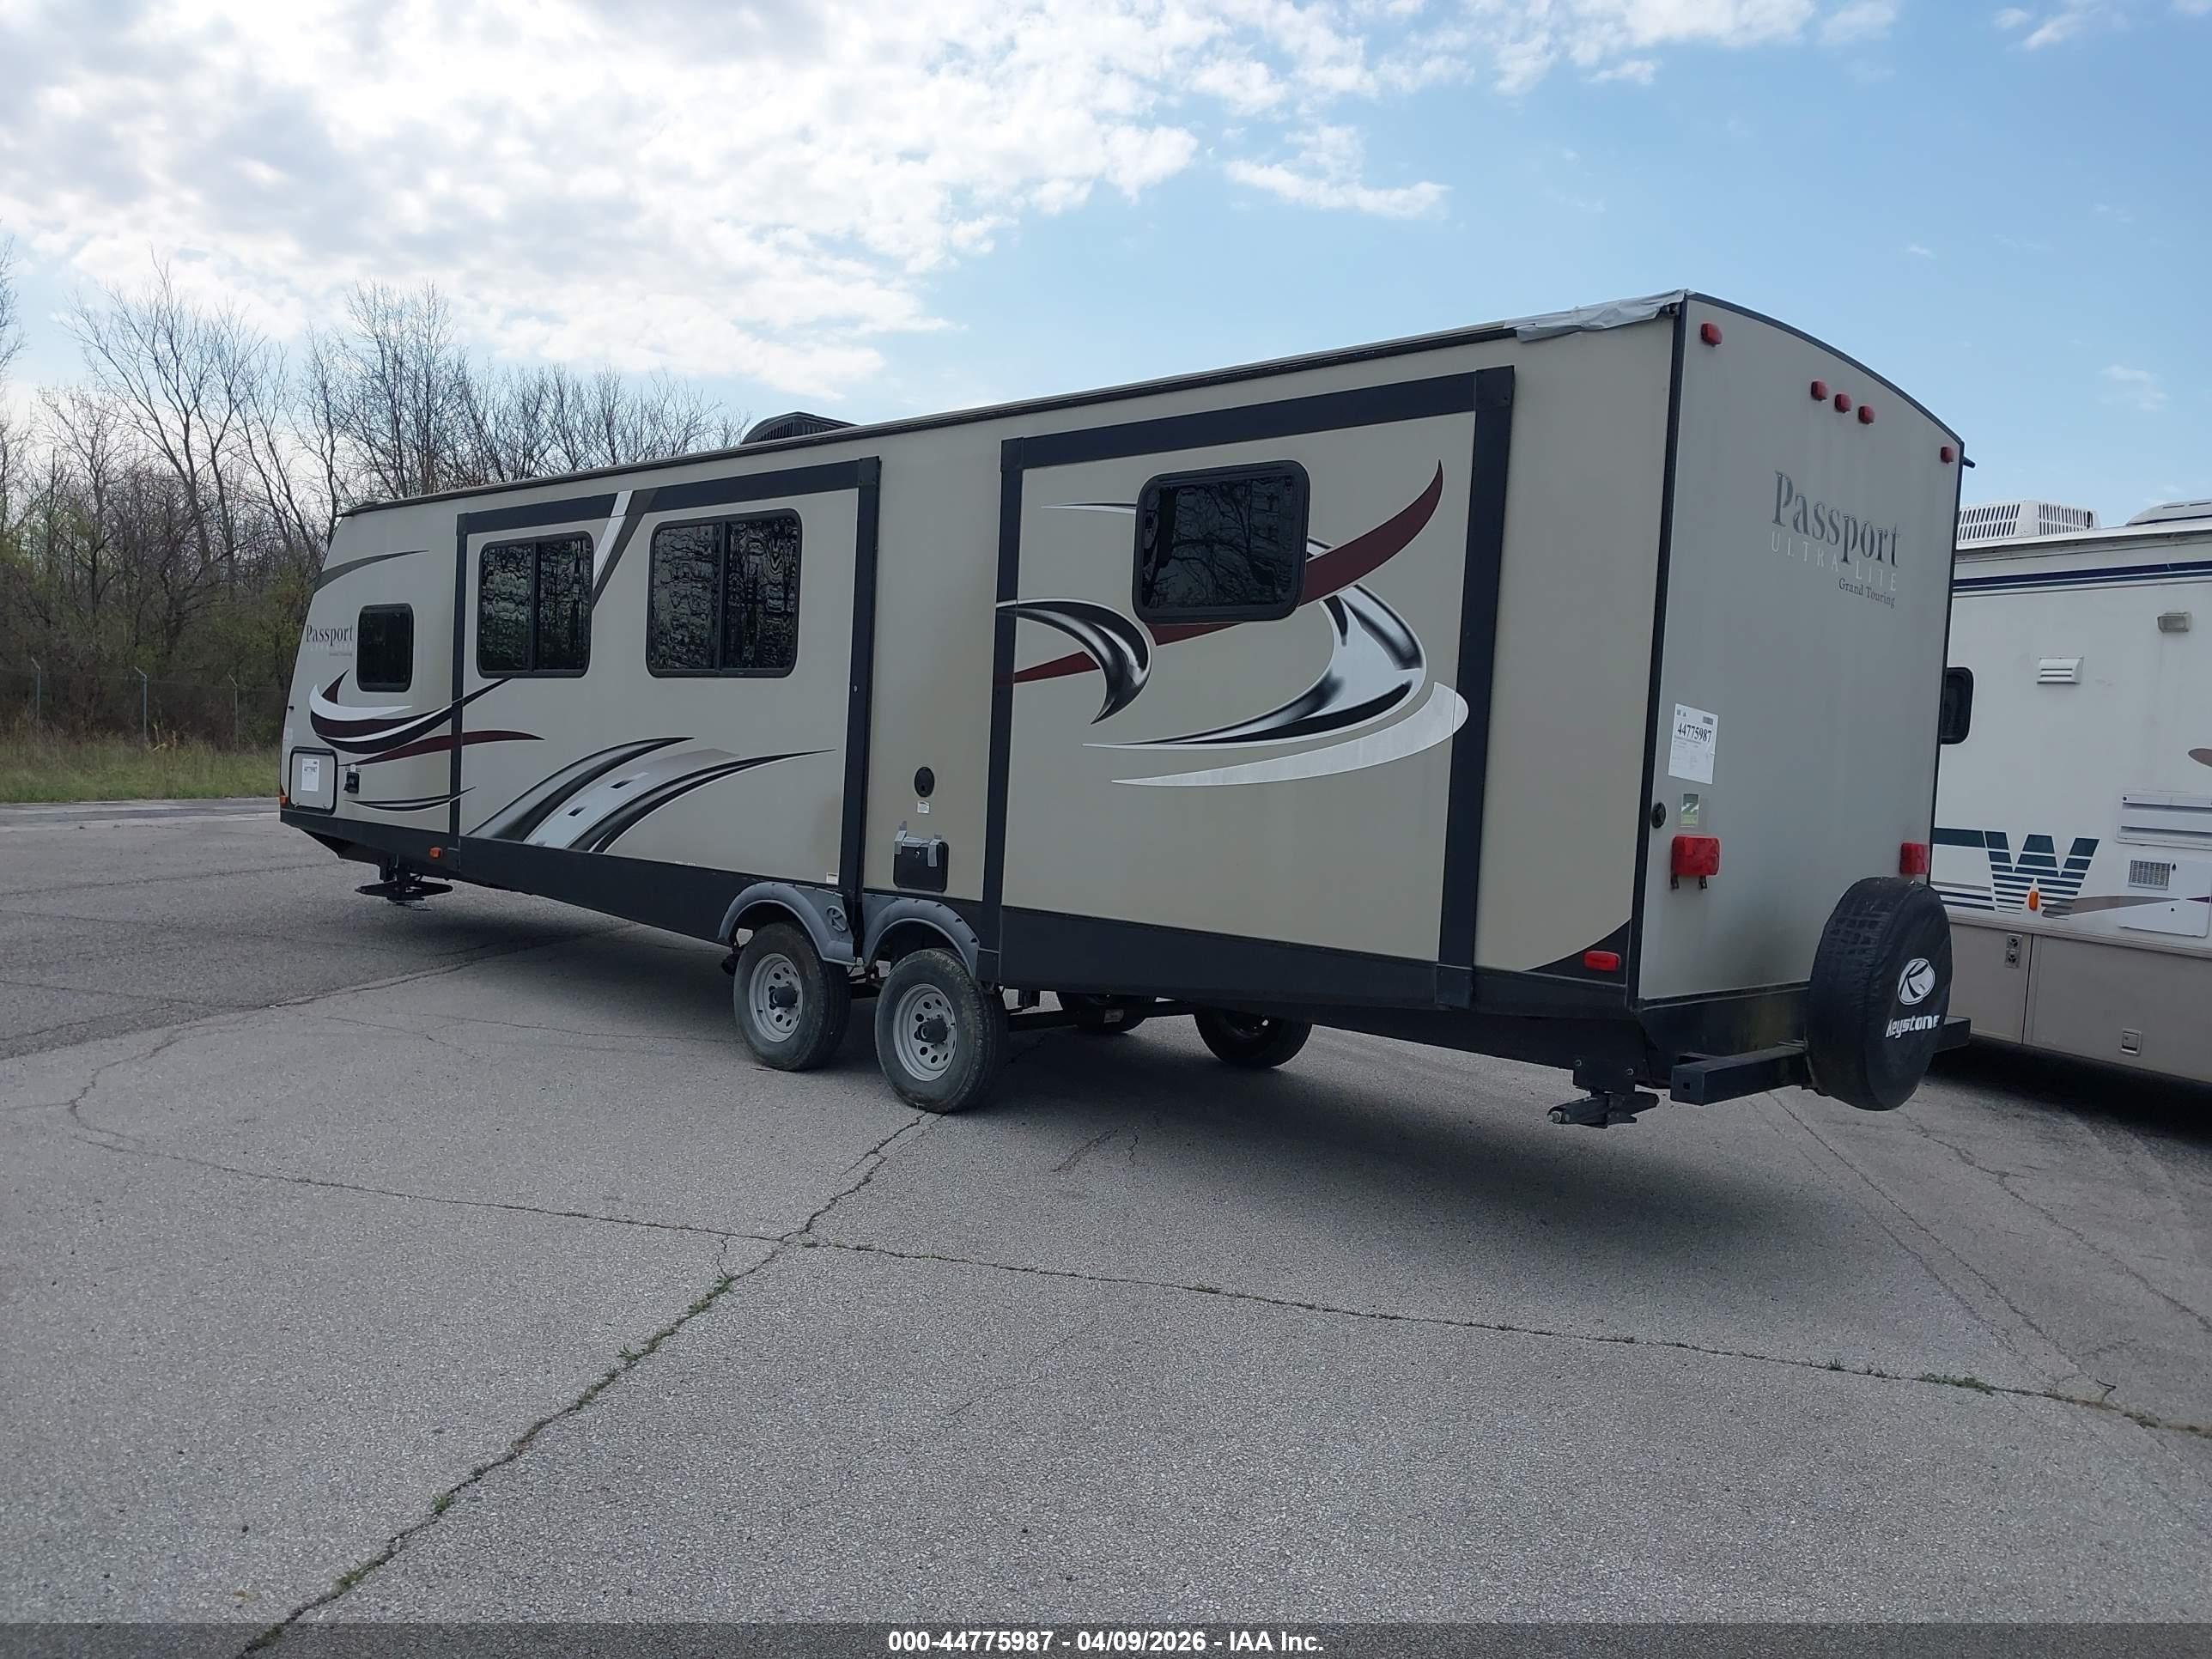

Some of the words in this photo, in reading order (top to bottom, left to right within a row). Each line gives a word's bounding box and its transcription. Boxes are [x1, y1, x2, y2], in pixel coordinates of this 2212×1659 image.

[1771, 470, 1900, 568] Passport
[1771, 531, 1839, 573] ULTRA
[1856, 561, 1897, 592] LITE
[1838, 577, 1864, 597] Grand
[1866, 586, 1896, 610] Touring
[306, 624, 353, 647] Passport
[1677, 722, 1712, 743] 44775987
[1885, 1014, 1942, 1040] Keystone
